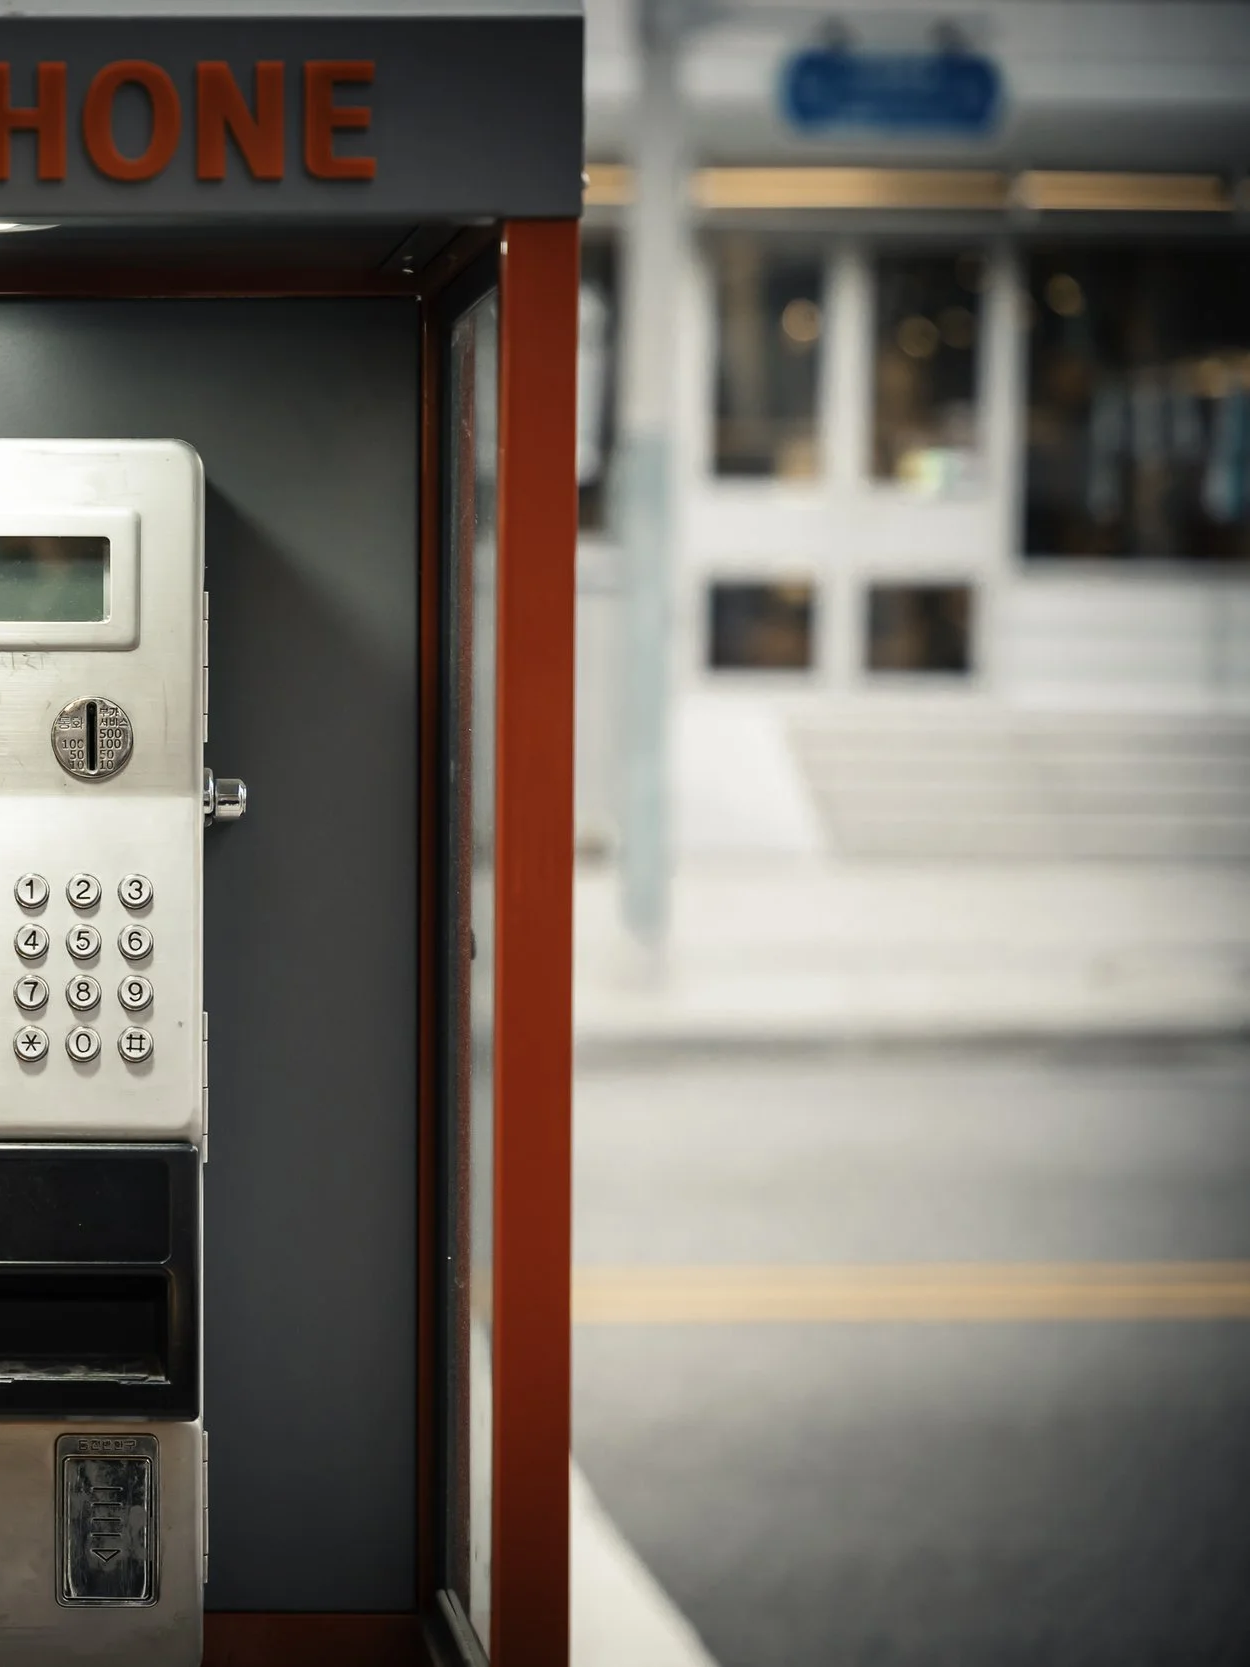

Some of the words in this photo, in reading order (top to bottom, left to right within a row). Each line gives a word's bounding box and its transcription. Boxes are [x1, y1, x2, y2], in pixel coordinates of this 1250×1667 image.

[99, 717, 128, 727] 서비스
[99, 728, 122, 739] 500
[62, 739, 84, 749] 100
[99, 739, 122, 749] 100
[69, 749, 85, 760] 50
[99, 749, 114, 760] 50
[70, 760, 85, 770] 10
[99, 760, 114, 770] 10
[25, 879, 34, 899] 1
[76, 879, 91, 900] 2
[128, 879, 143, 900] 3
[23, 930, 39, 950] 4
[76, 930, 91, 950] 5
[128, 931, 143, 951] 6
[23, 981, 39, 1002] 7
[76, 982, 91, 1001] 8
[128, 982, 143, 1002] 9
[76, 1033, 91, 1053] 0
[126, 1034, 145, 1052] #
